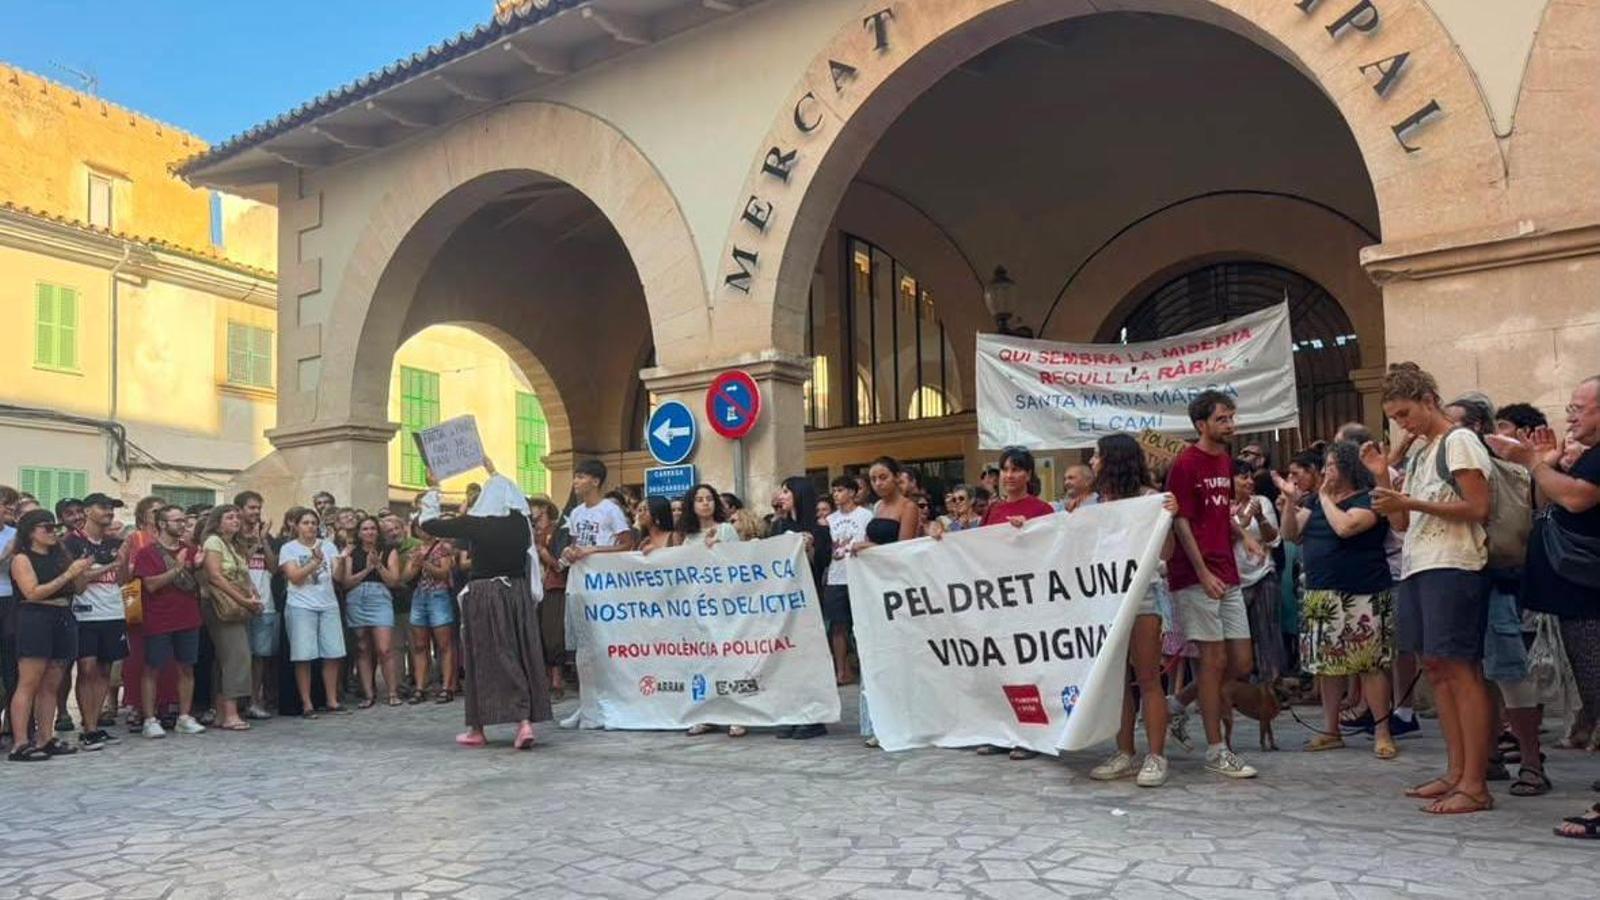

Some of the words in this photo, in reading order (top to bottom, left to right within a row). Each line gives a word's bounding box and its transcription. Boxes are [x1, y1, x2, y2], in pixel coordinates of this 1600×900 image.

[724, 6, 897, 296] MERCAT
[998, 349, 1031, 362] QUI
[1039, 350, 1122, 365] SEMBRA
[1128, 351, 1156, 363] LA
[1124, 373, 1150, 384] LA
[1015, 394, 1077, 410] SANTA
[1083, 392, 1149, 408] MARIA
[1077, 417, 1101, 432] EL
[585, 565, 722, 591] MANIFESTAR-SE
[728, 563, 768, 583] PER
[772, 558, 795, 579] CA
[883, 585, 944, 621] PEL
[948, 573, 1035, 613] DRET
[1048, 570, 1071, 602] A
[1075, 559, 1138, 598] UNA
[585, 600, 664, 622] NOSTRA
[668, 599, 691, 617] NO
[698, 589, 718, 616] ÉS
[722, 589, 807, 616] DELICTE!
[608, 643, 650, 658] PROU
[653, 636, 719, 657] VIOLÈNCIA
[722, 636, 797, 657] POLICIAL
[927, 635, 1006, 667] VIDA
